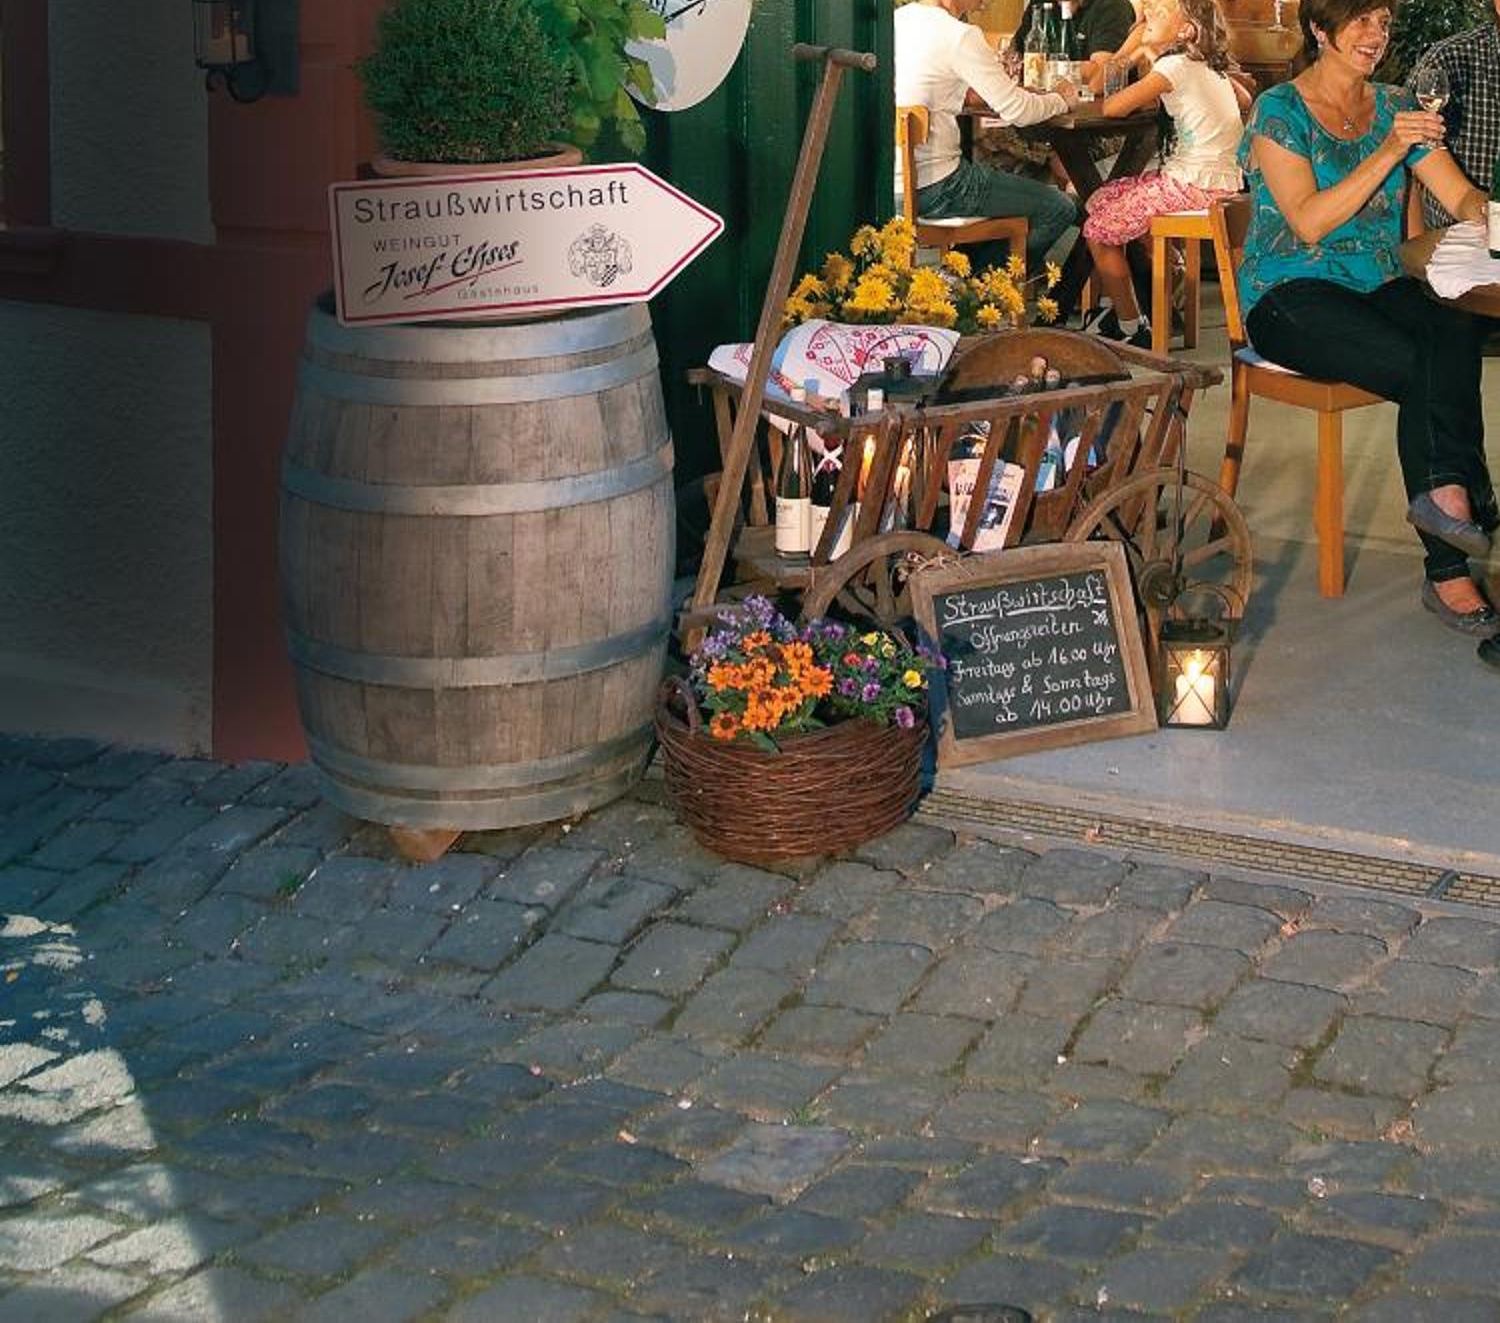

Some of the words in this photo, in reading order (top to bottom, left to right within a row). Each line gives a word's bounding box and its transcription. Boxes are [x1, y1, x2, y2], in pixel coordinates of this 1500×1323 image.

[354, 180, 629, 223] Straußwirtschaft
[372, 234, 461, 253] WEINGUT
[363, 251, 447, 302] Josef
[943, 576, 1105, 619] Straußwirtschaft
[1021, 651, 1042, 670] ab
[1093, 641, 1117, 664] Uhr
[1021, 674, 1033, 695] &
[1043, 670, 1117, 694] Sonntags
[995, 706, 1019, 724] ab
[1029, 694, 1082, 720] 14.00
[1085, 692, 1115, 714] Uhr
